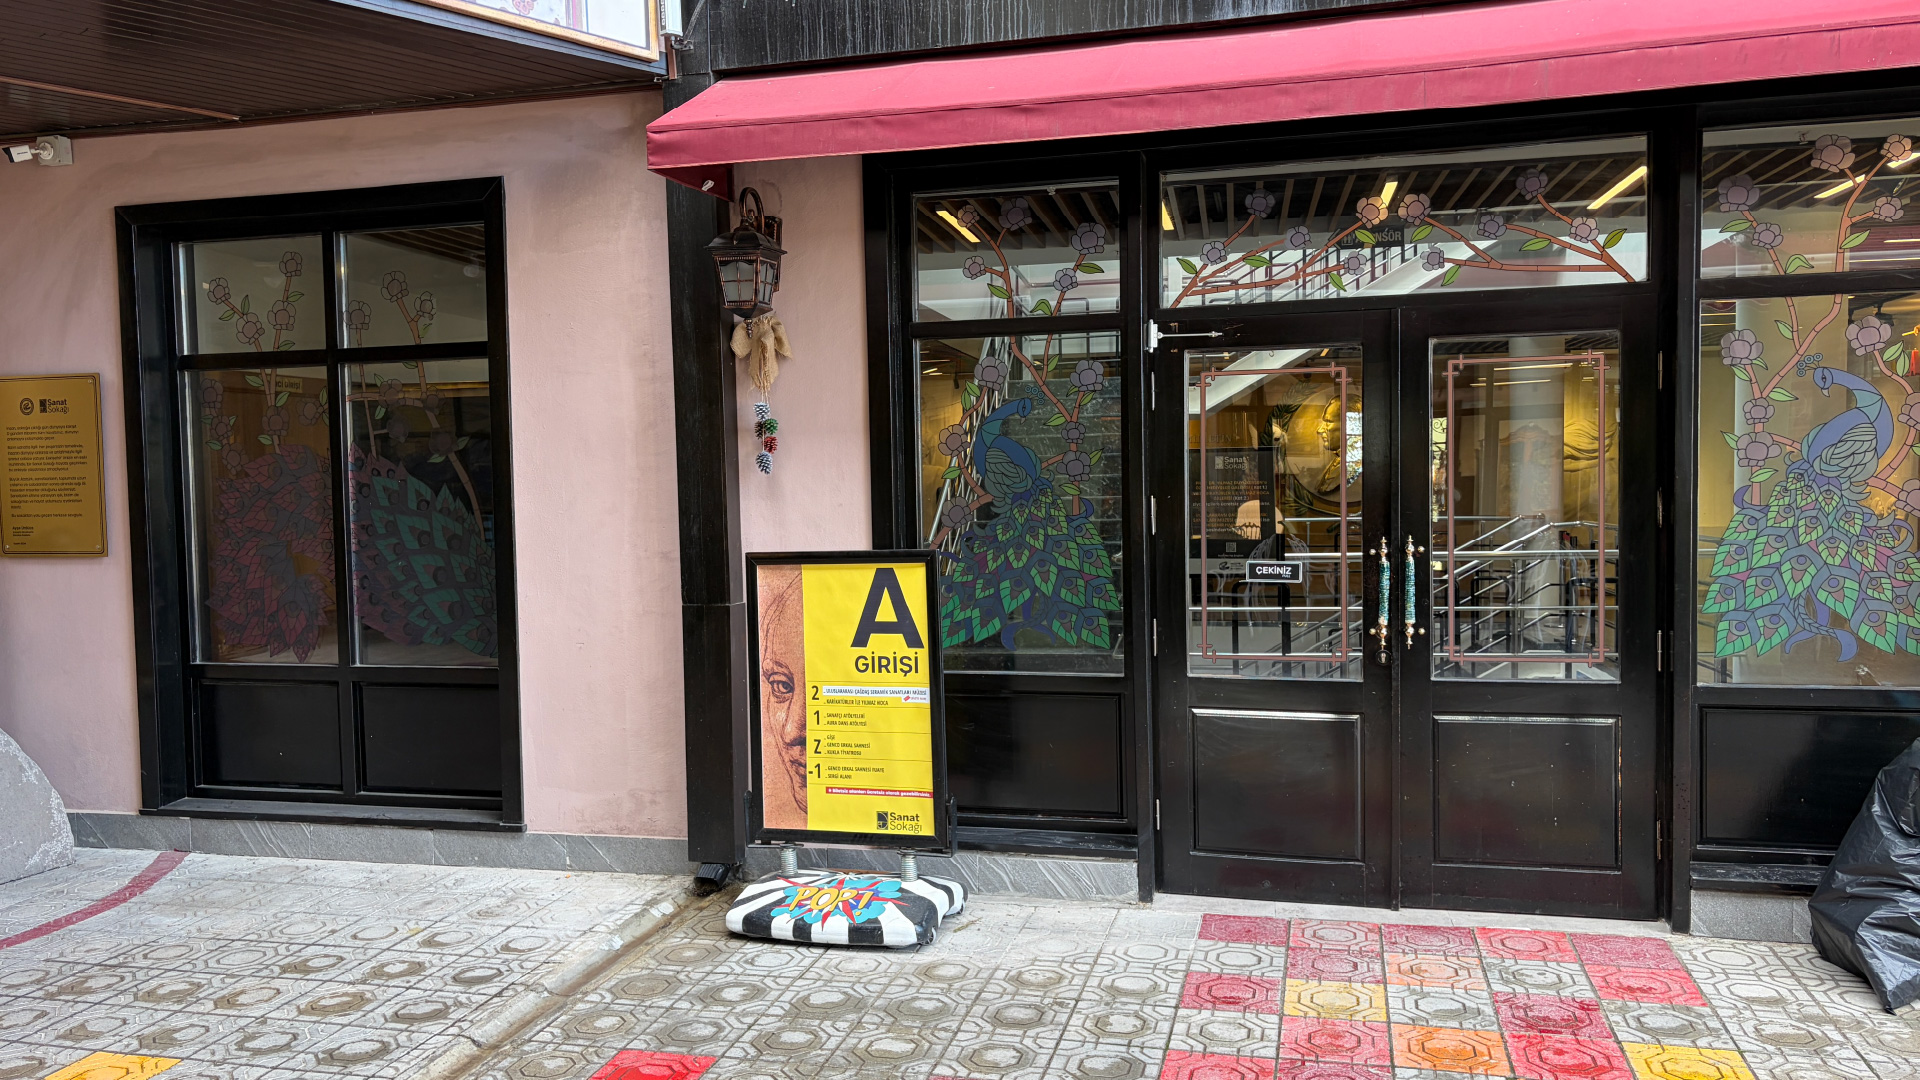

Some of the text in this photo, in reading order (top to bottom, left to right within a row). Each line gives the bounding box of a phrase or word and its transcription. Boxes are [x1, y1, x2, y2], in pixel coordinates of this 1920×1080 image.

[47, 398, 68, 406] Sanat
[47, 405, 70, 415] Sokağı
[1255, 565, 1292, 575] ÇEKİNİZ
[850, 567, 925, 649] A
[854, 650, 919, 678] GİRİŞİ
[811, 685, 820, 701] 2
[813, 710, 820, 726] 1
[813, 739, 822, 755] Z
[889, 812, 920, 822] Sanat
[889, 820, 923, 835] Sokağı
[788, 886, 874, 917] POP!
